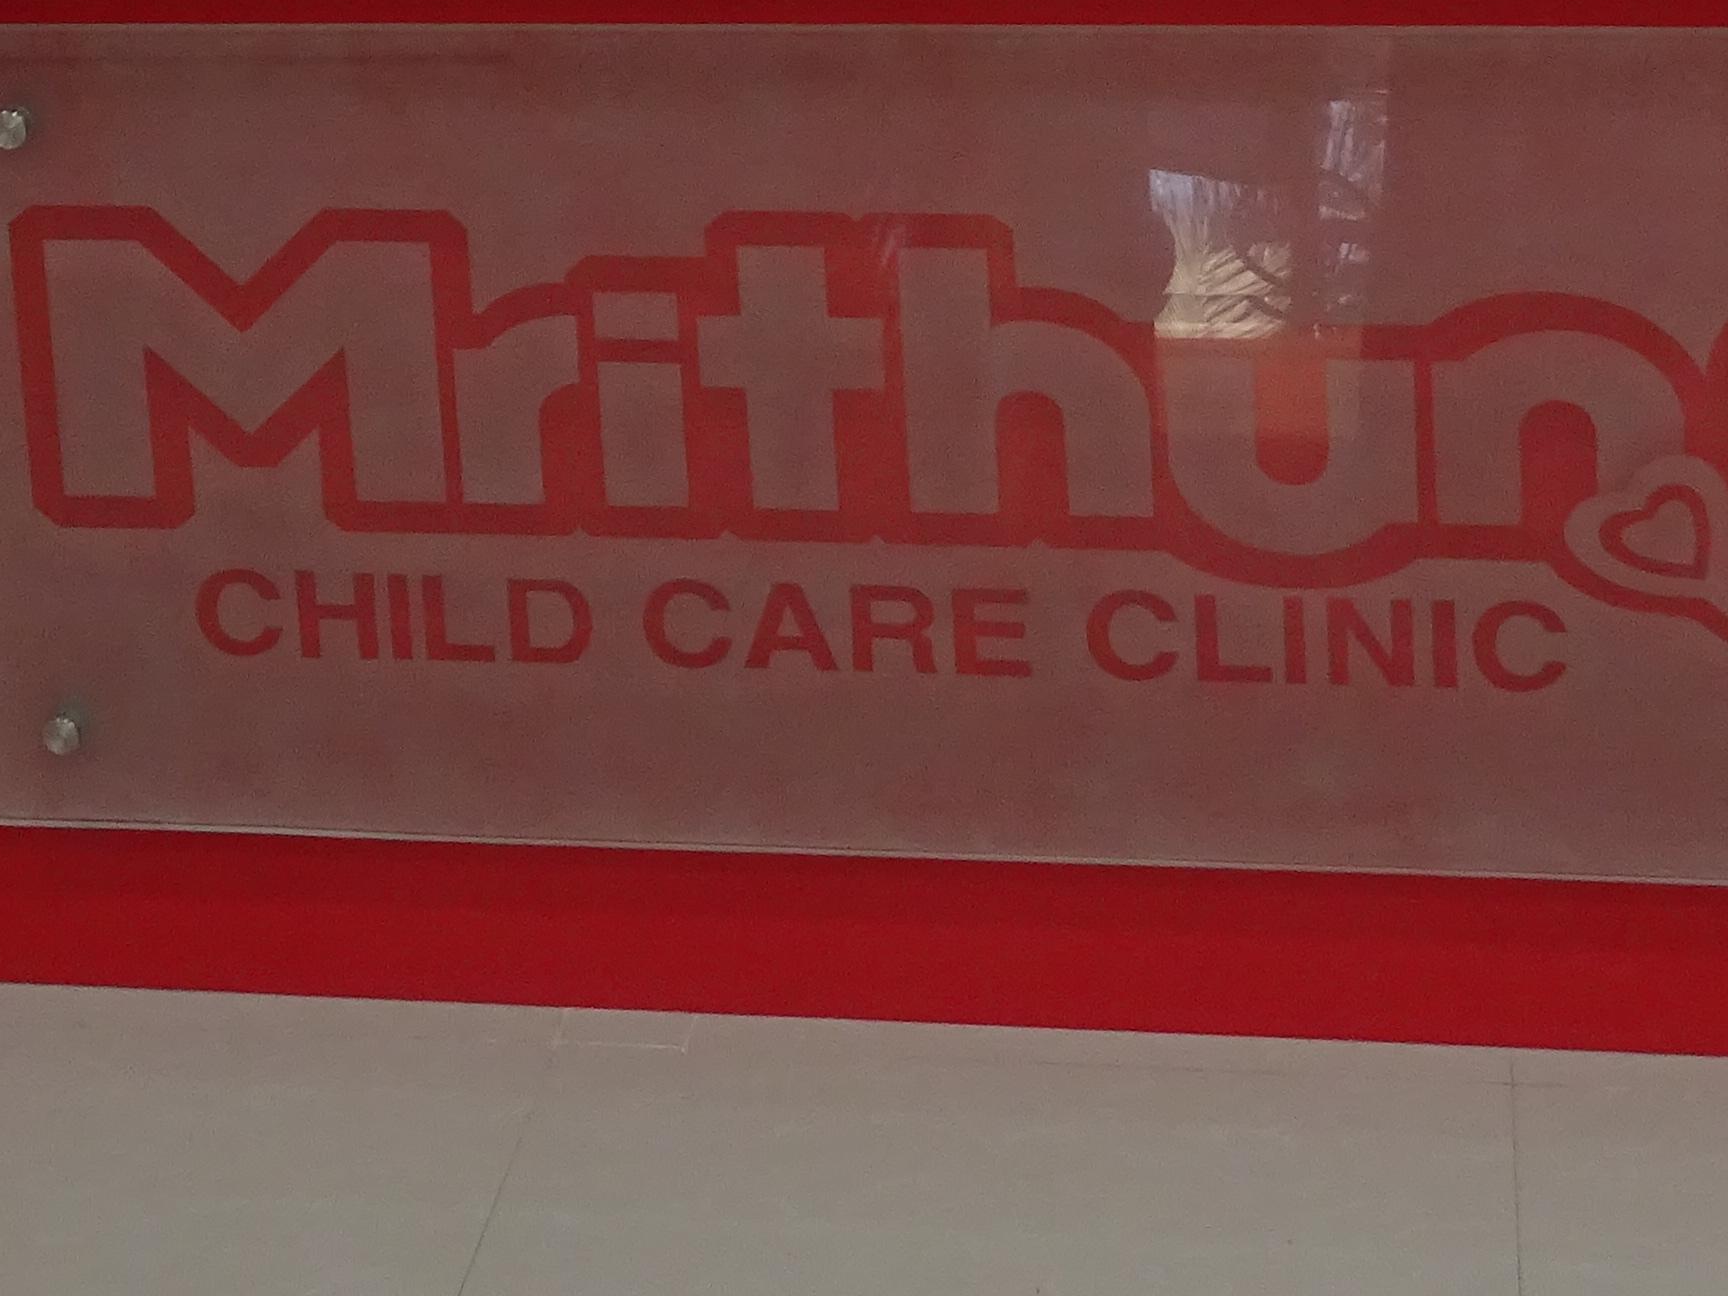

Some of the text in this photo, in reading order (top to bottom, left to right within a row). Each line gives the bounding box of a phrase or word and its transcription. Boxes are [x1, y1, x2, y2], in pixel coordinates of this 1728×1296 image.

[40, 238, 1686, 556] Mrithun
[193, 568, 1569, 692] CHILD CARE CLINIC
